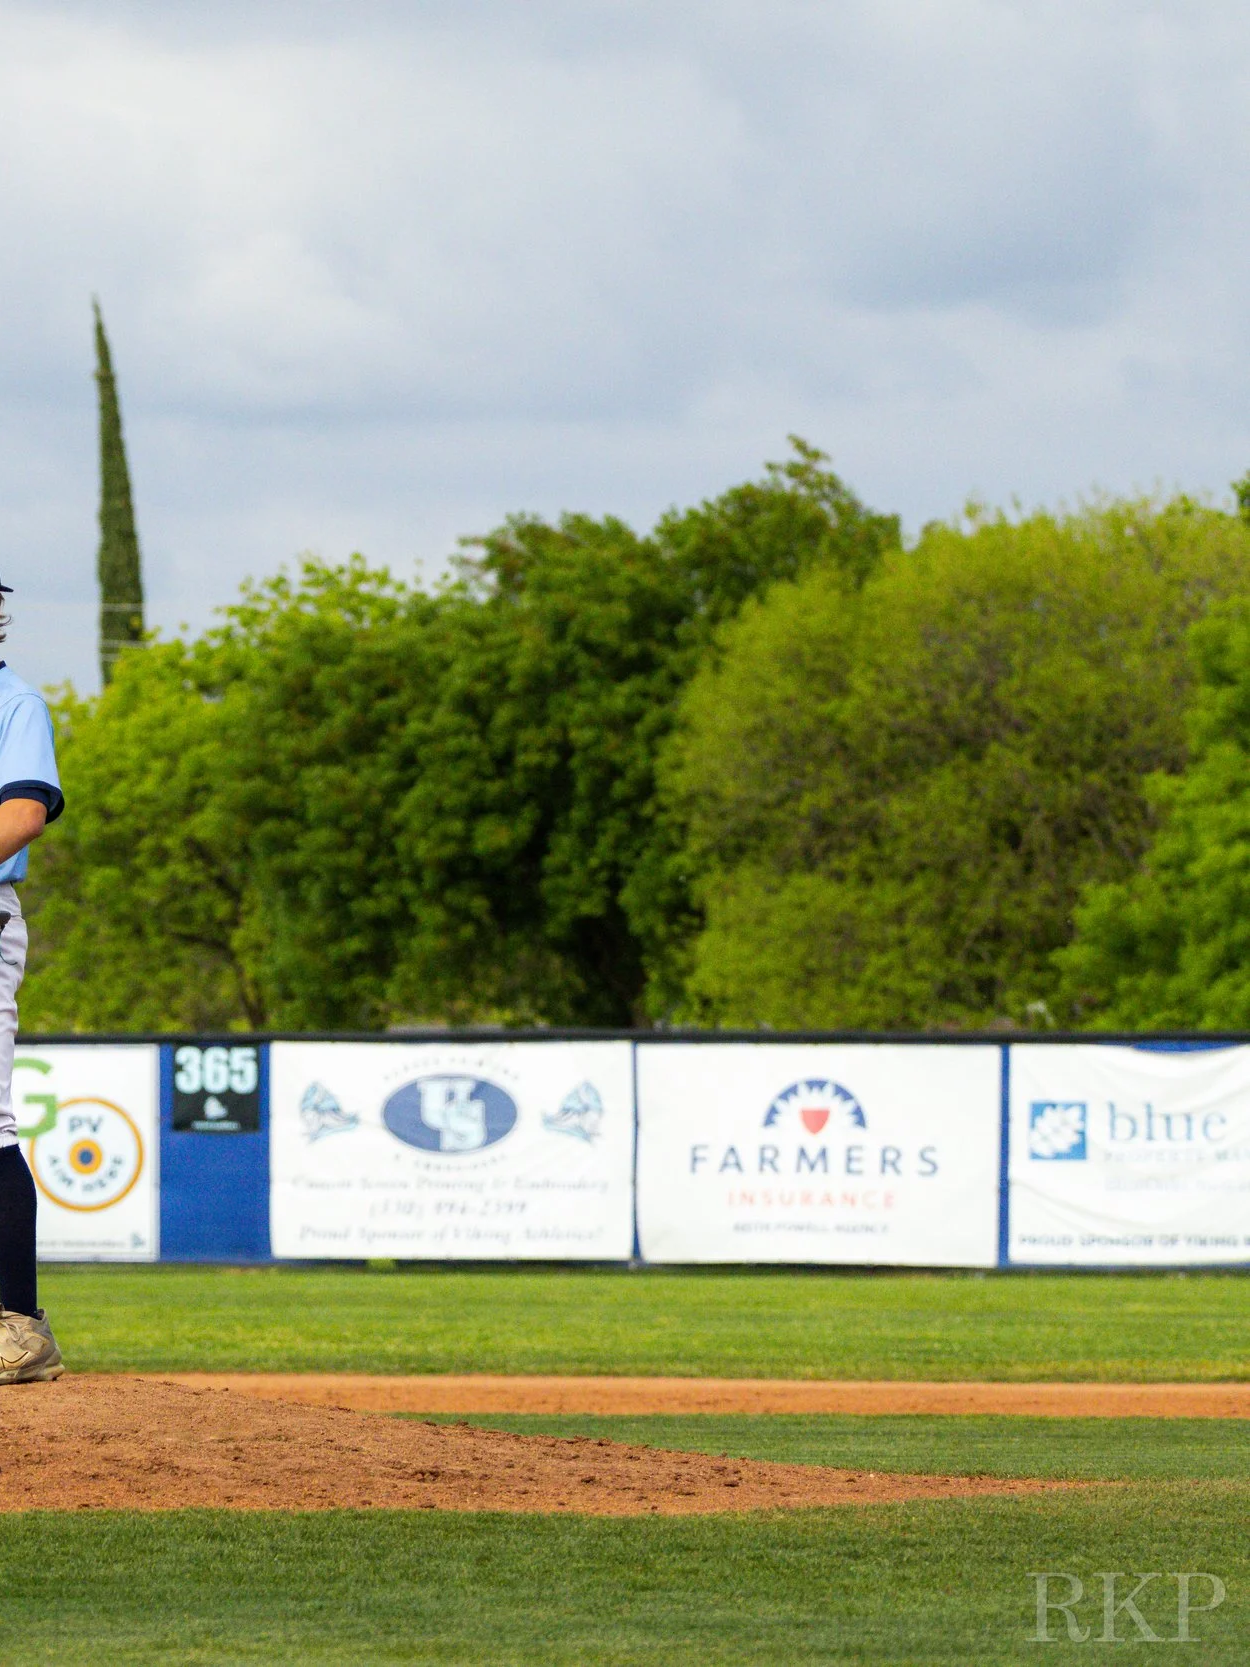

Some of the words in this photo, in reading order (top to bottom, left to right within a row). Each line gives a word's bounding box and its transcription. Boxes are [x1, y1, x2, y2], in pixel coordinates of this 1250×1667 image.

[174, 1045, 258, 1095] 365
[68, 1115, 104, 1134] PV
[1106, 1101, 1227, 1142] blue
[689, 1144, 940, 1177] FARMERS
[727, 1188, 896, 1210] INSURANCE
